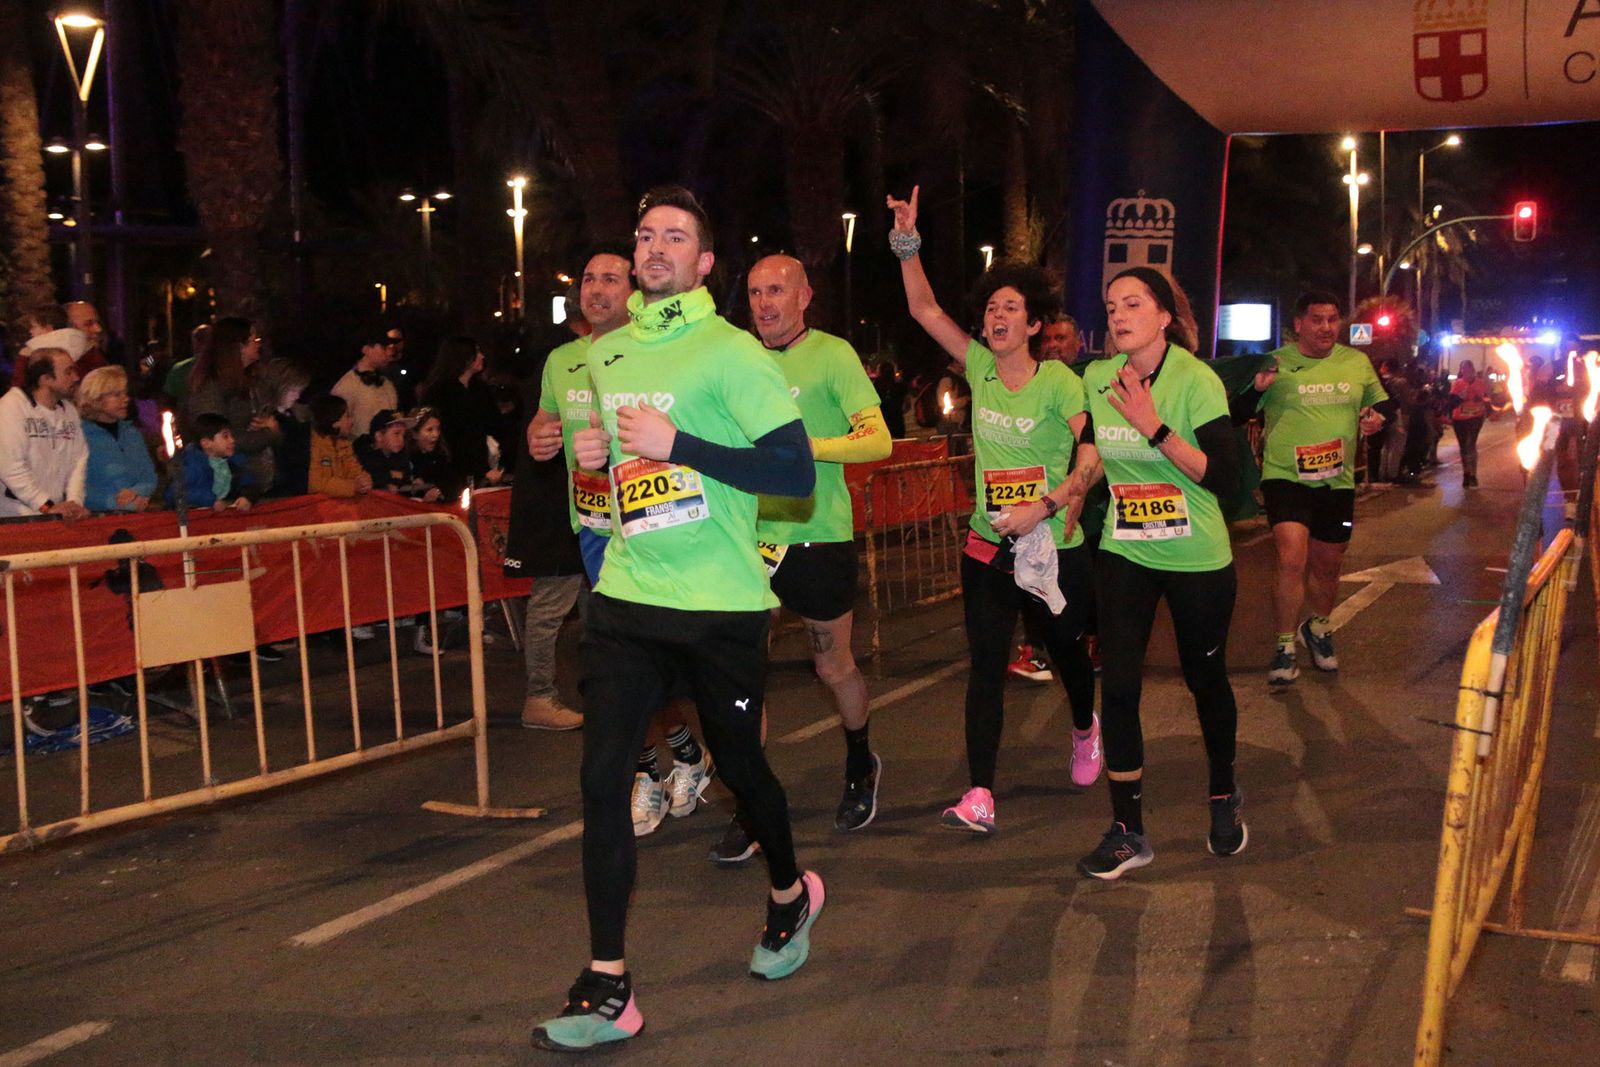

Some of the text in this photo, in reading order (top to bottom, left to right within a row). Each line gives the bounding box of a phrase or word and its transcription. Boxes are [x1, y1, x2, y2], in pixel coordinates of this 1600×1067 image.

[979, 407, 1013, 428] sano
[1098, 426, 1140, 442] sano
[1308, 451, 1338, 466] 2259
[626, 471, 686, 503] 2203
[995, 484, 1037, 500] 2247
[580, 490, 611, 508] 228
[1130, 500, 1176, 517] 2186
